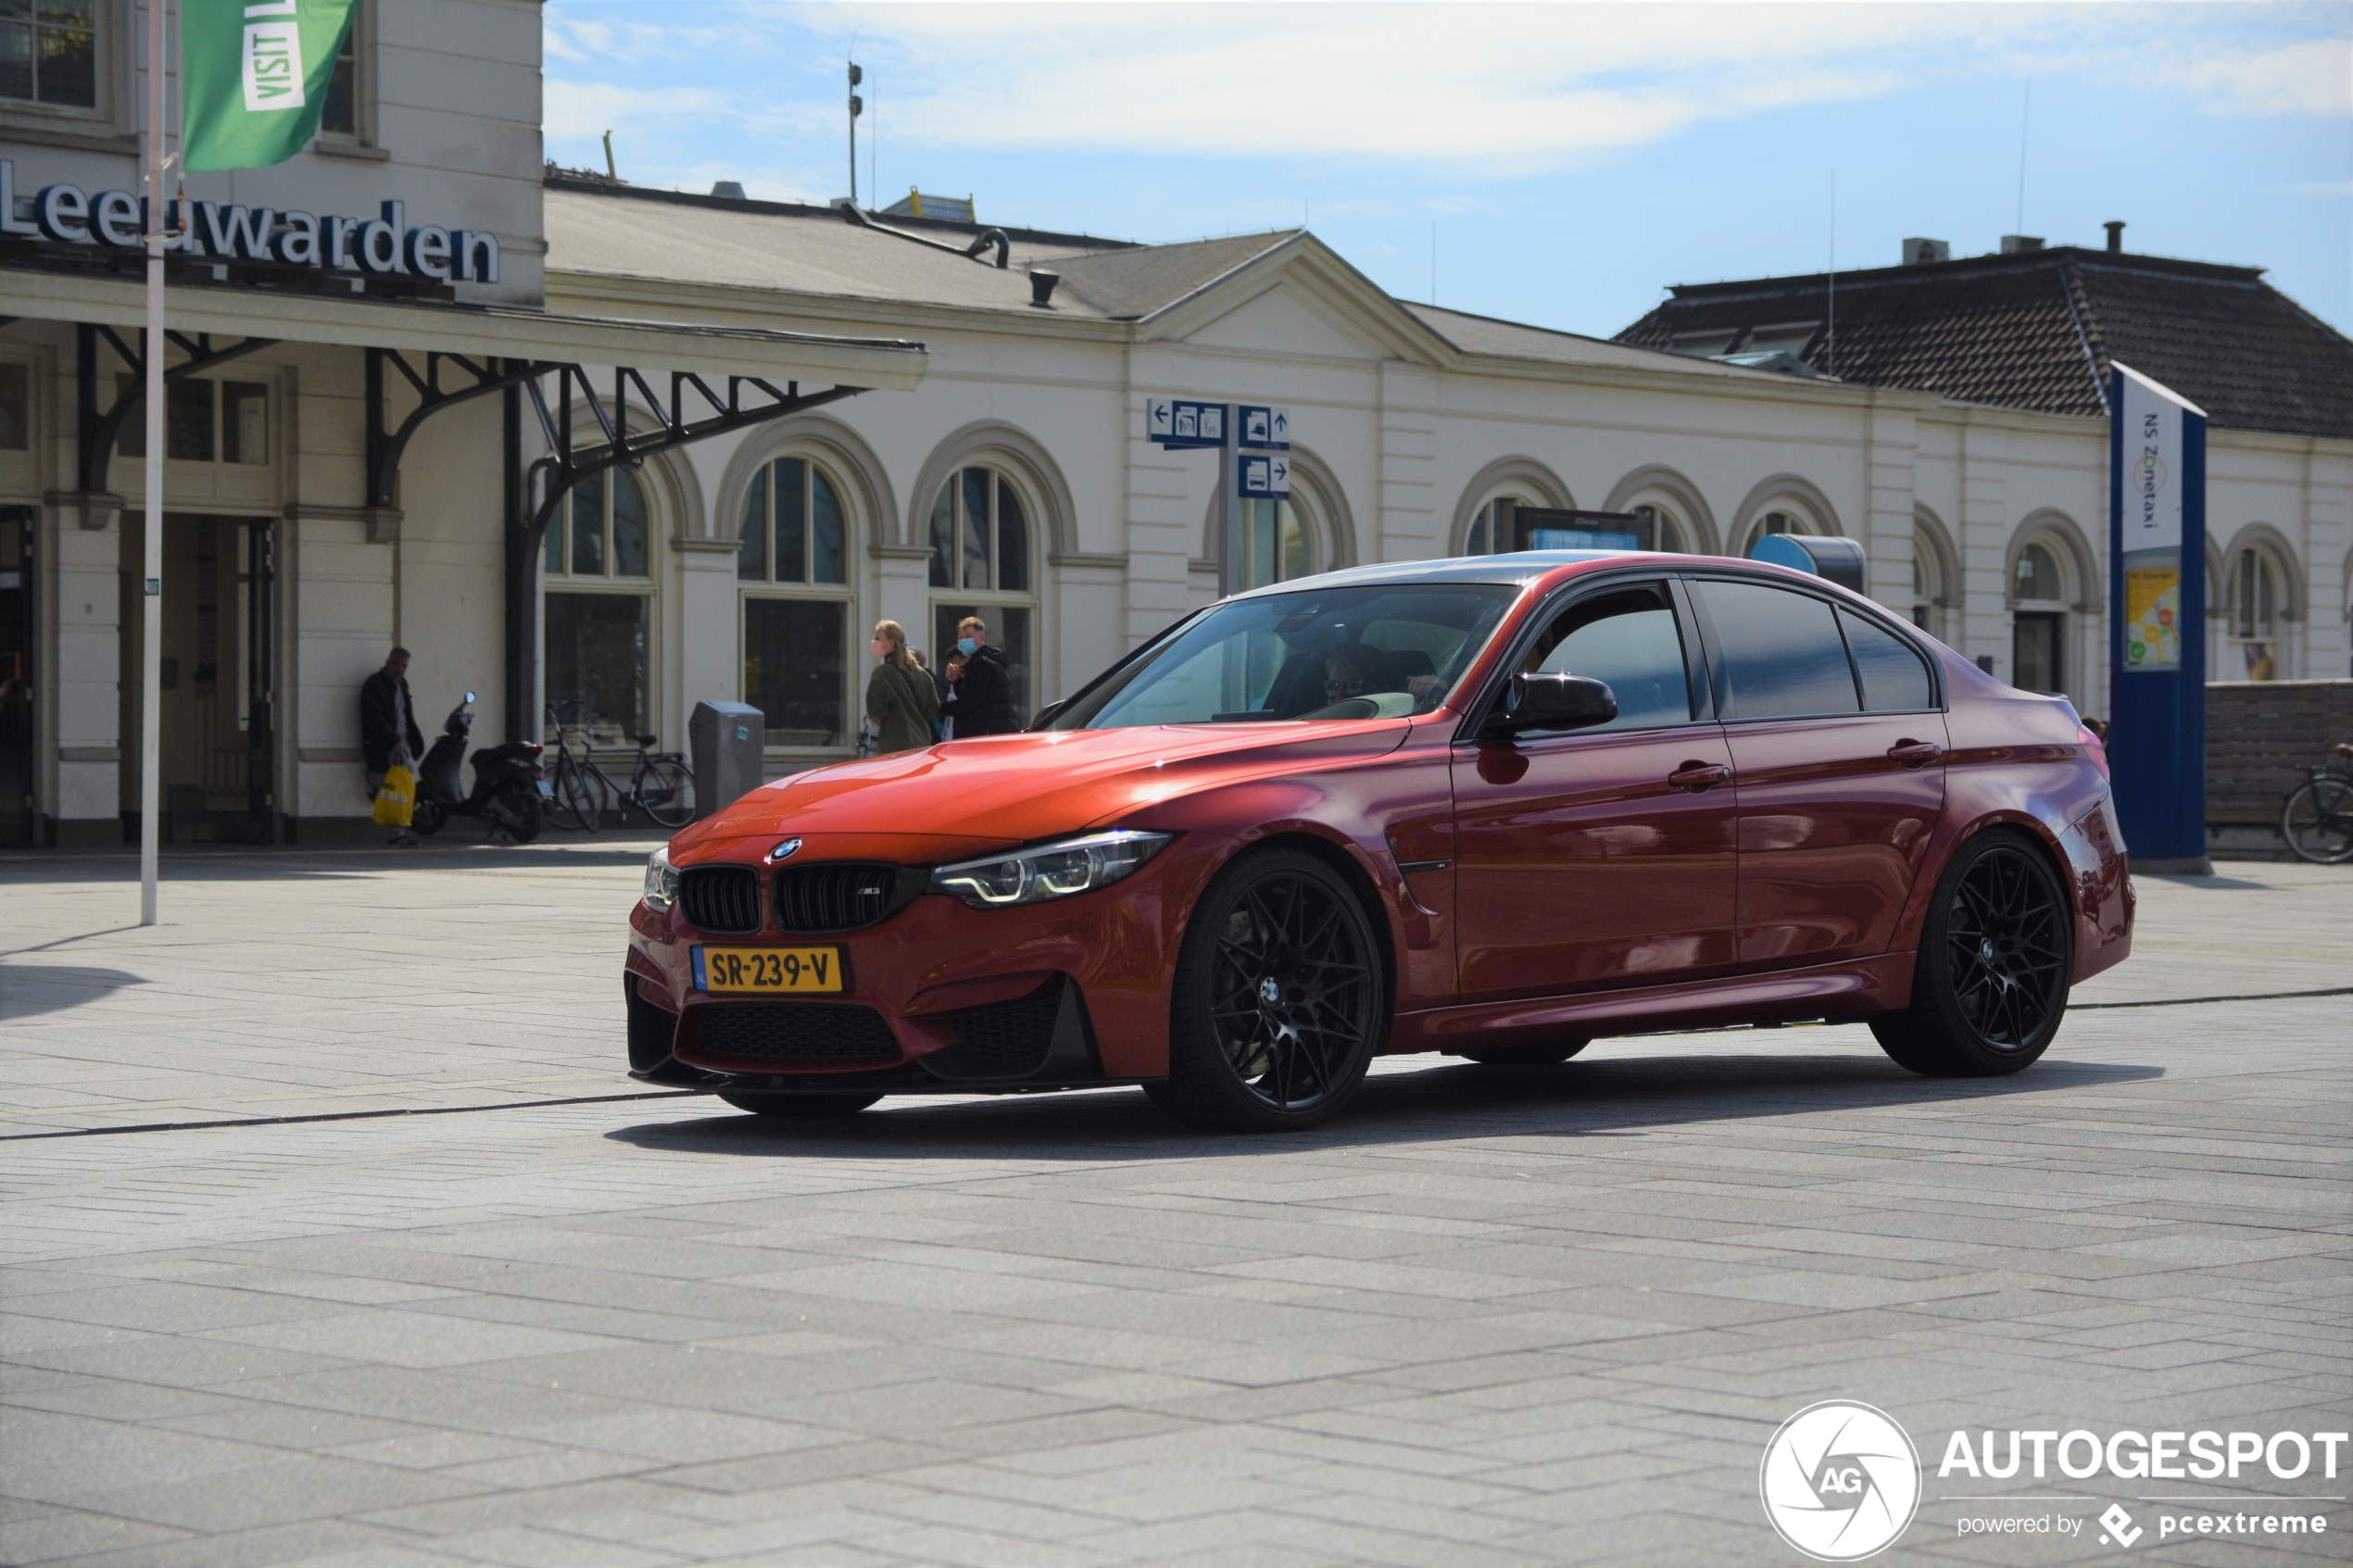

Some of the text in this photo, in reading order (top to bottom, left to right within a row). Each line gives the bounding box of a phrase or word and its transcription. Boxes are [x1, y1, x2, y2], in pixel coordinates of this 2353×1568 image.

[253, 33, 292, 100] VISIT
[2144, 413, 2159, 529] NS Zonetaxi
[697, 954, 827, 985] NL SR-239-V
